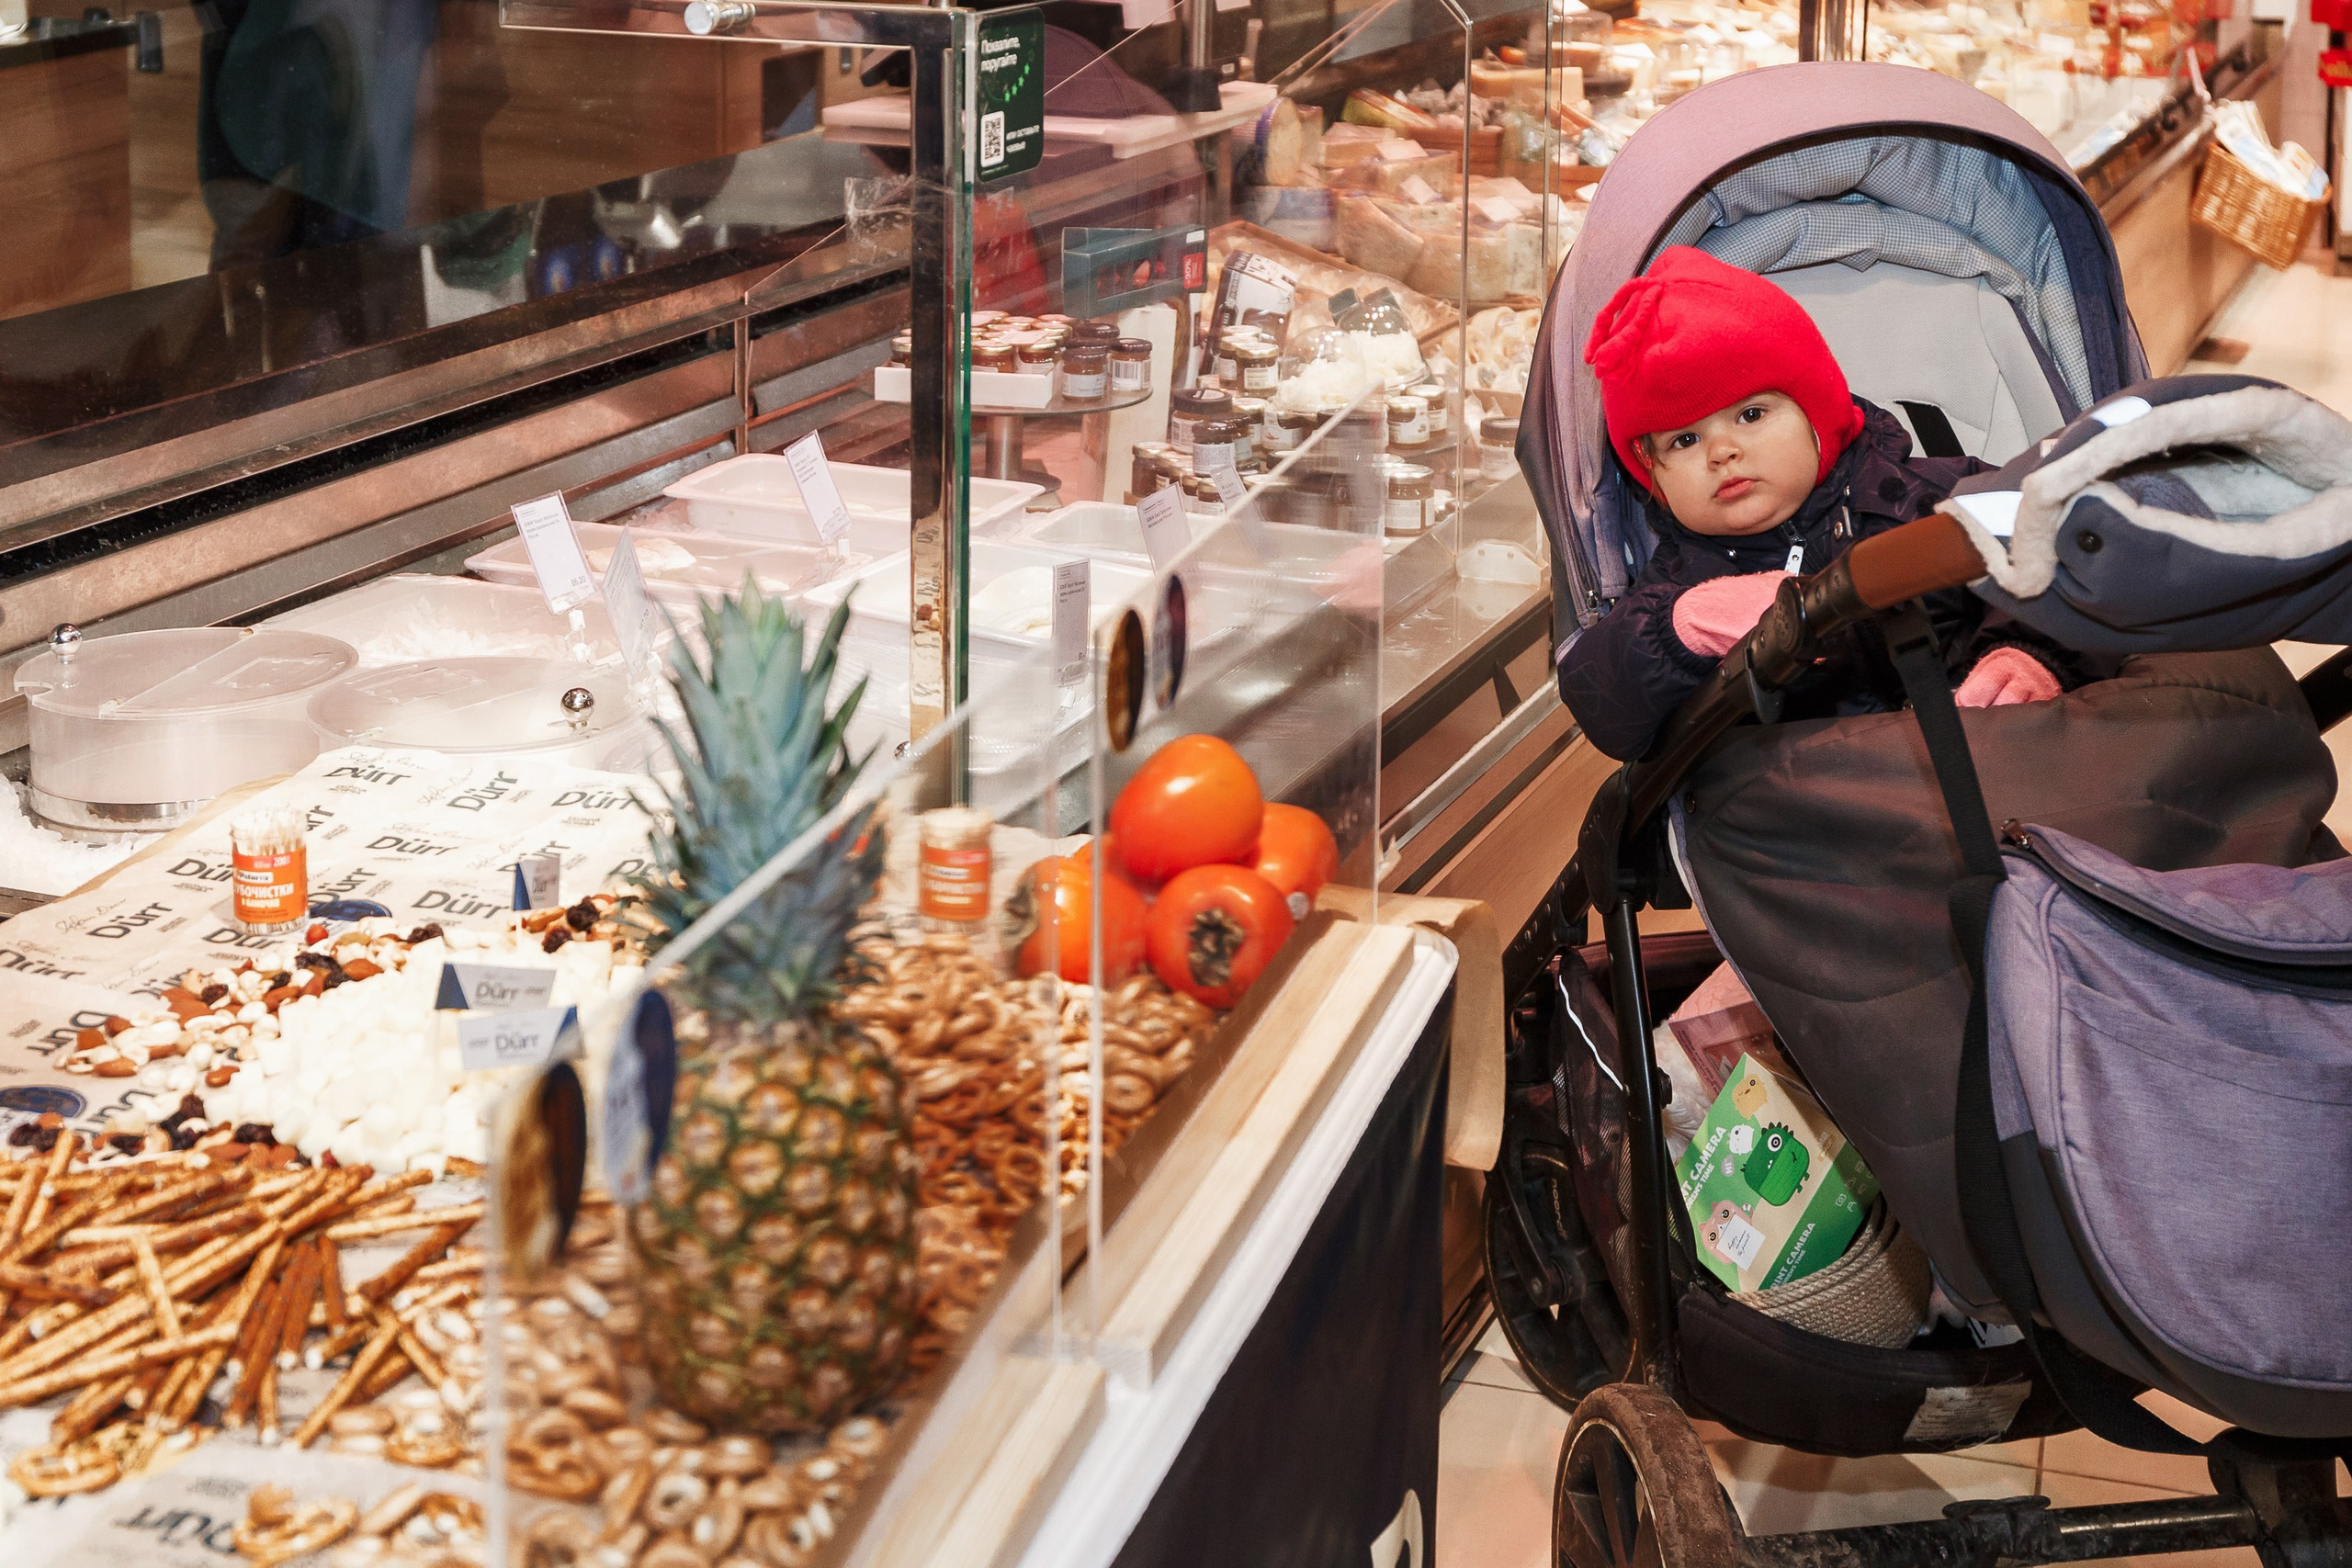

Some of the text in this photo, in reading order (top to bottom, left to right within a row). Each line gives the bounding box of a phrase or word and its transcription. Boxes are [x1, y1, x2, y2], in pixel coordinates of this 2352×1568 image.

[323, 764, 411, 785] Dürr
[447, 770, 518, 812] Dürr
[550, 791, 647, 811] Dürr
[365, 835, 458, 856] Dürr
[234, 883, 294, 899] УБОЧИСТКИ
[412, 889, 510, 919] Dürr
[86, 901, 174, 939] Dürr
[476, 981, 519, 1000] Dürr
[494, 1031, 539, 1051] Dürr
[1690, 1126, 1727, 1179] CAMERA
[1700, 1163, 1715, 1184] TIME
[1785, 1222, 1816, 1272] CAMERA
[1793, 1247, 1807, 1269] TIME
